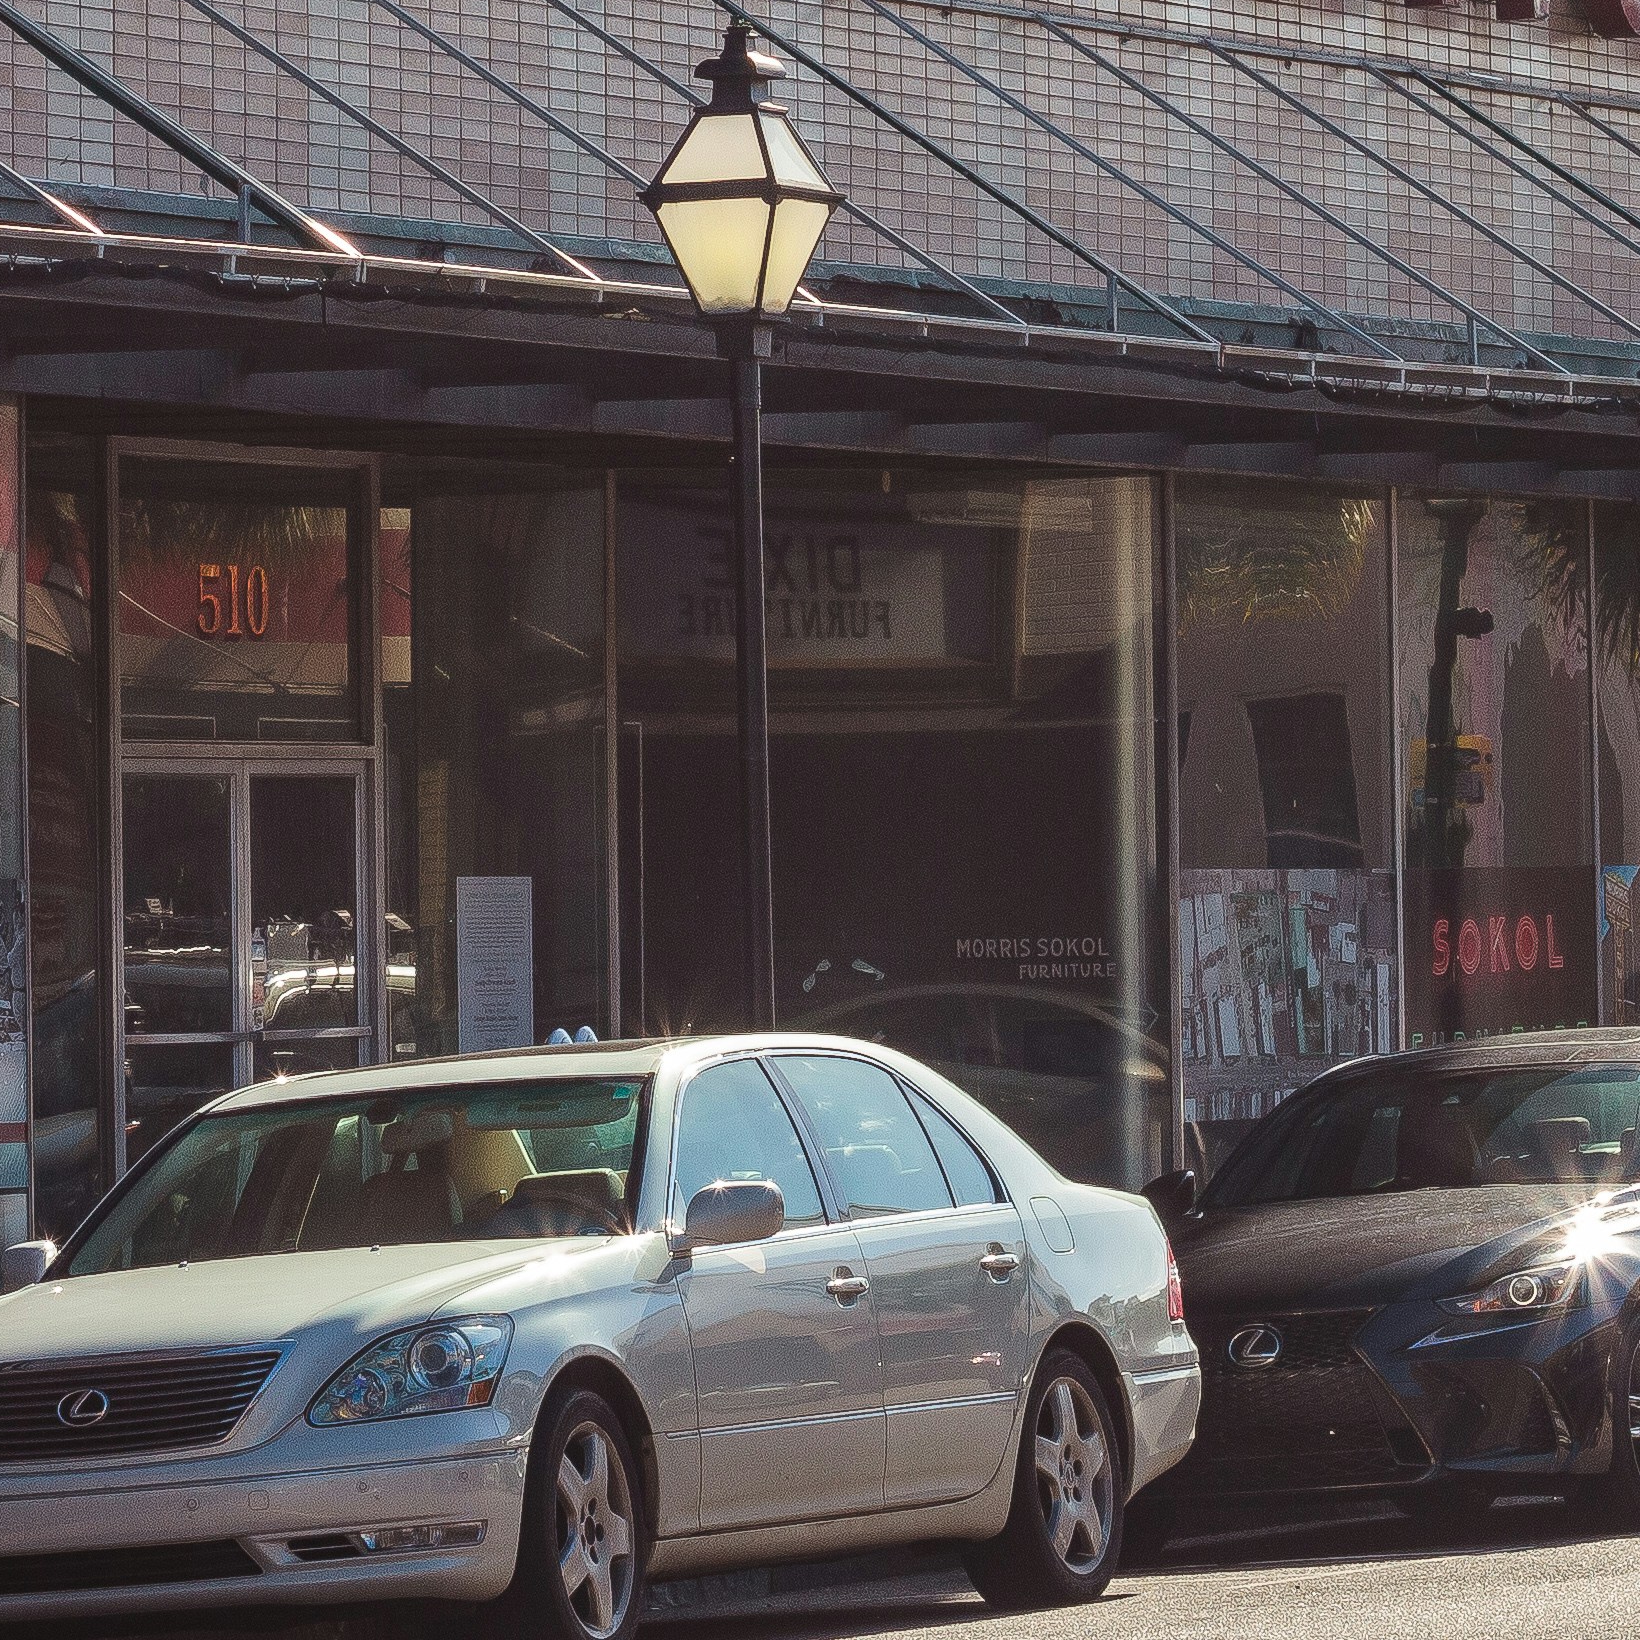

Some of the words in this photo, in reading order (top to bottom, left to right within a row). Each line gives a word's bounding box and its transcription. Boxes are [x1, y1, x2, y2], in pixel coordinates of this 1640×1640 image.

[198, 564, 269, 635] 510
[957, 938, 1031, 958] MORRIS
[1037, 937, 1110, 958] SOKOL
[1432, 914, 1564, 976] SOKOL
[1019, 963, 1117, 979] FURNITURE
